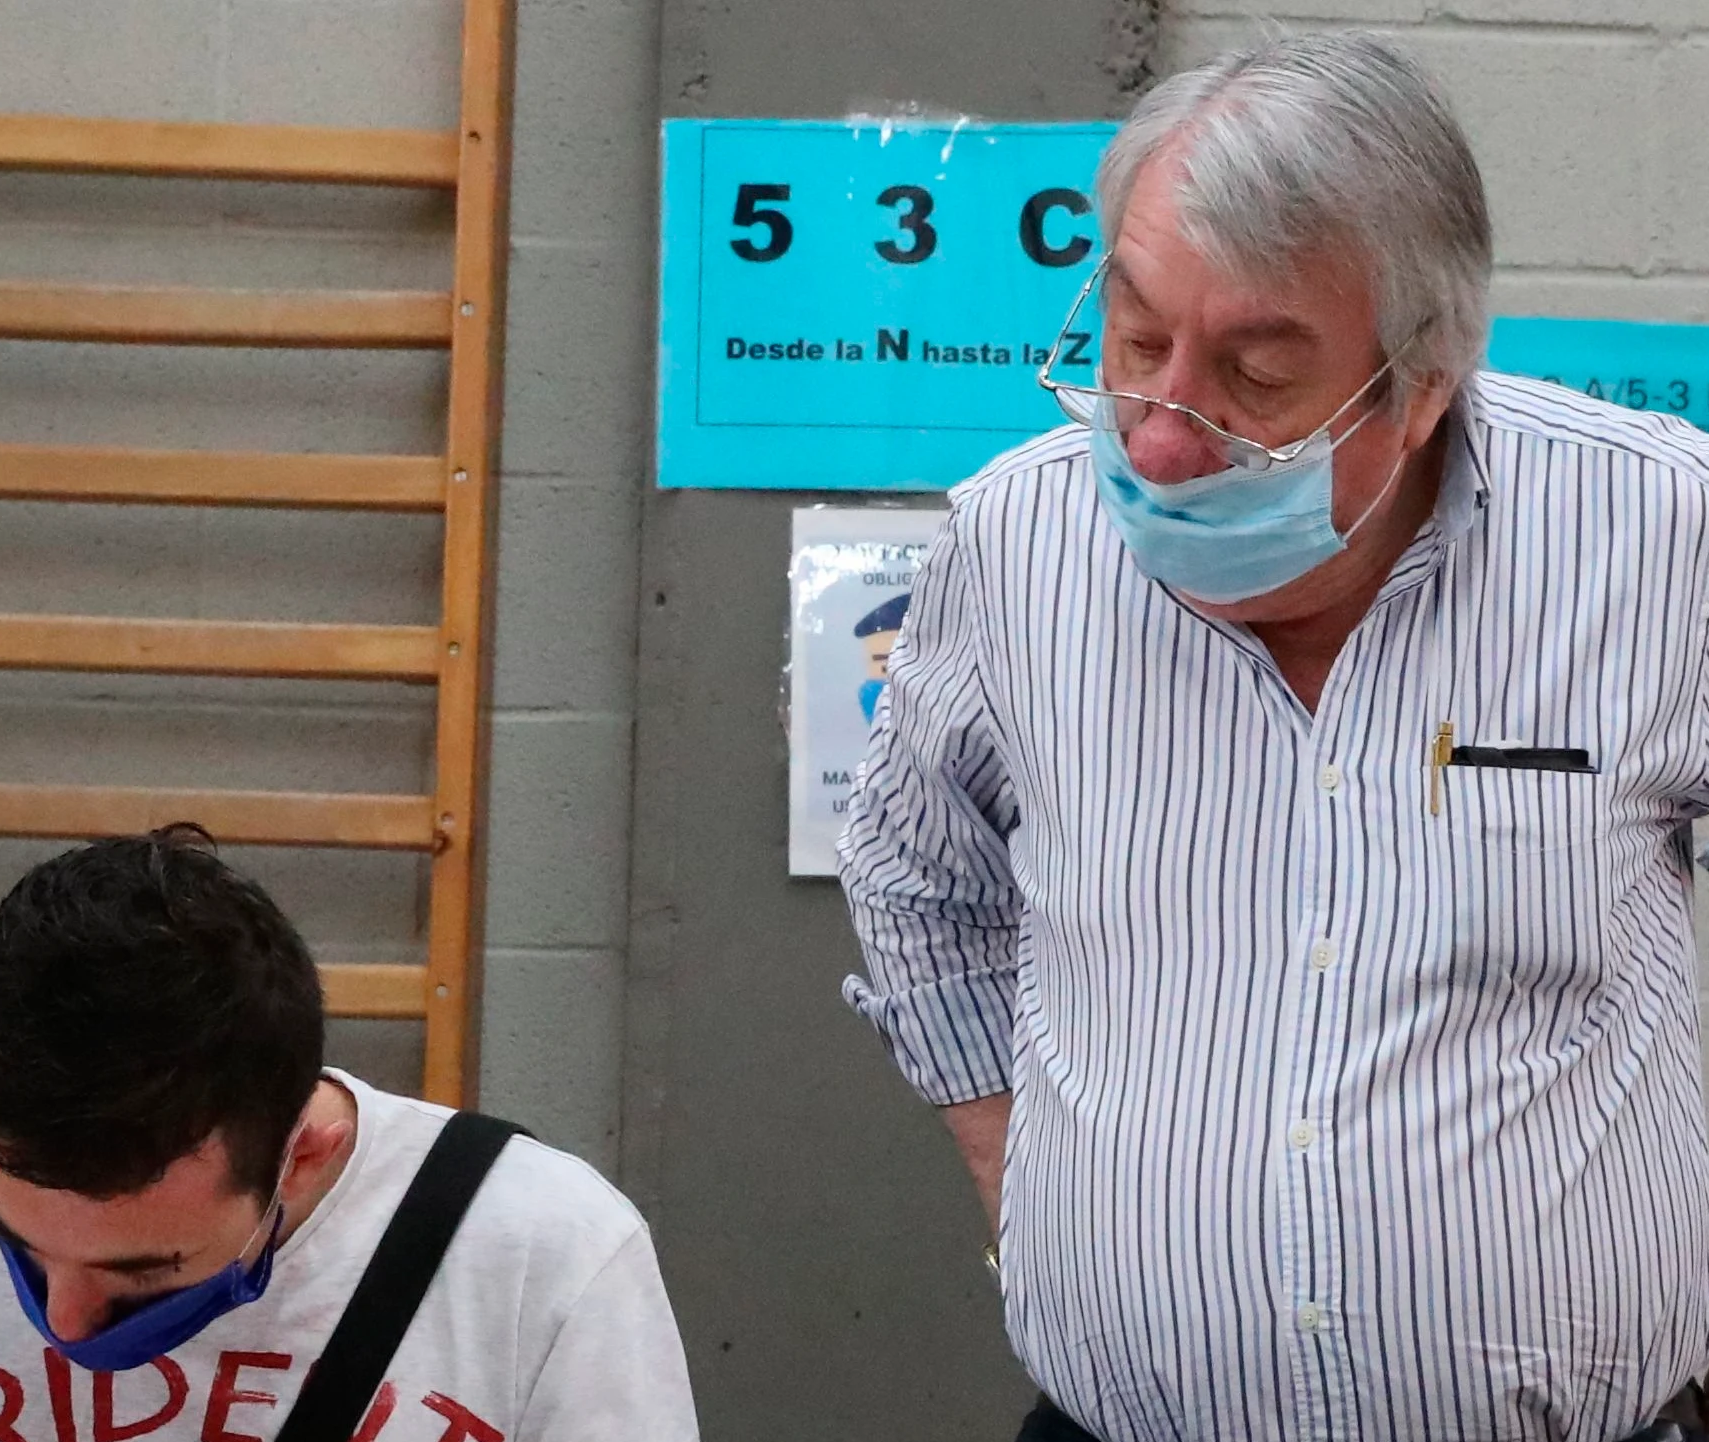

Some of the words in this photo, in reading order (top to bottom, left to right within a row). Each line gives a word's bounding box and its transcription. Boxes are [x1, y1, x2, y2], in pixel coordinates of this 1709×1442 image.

[731, 184, 793, 262] 5
[875, 185, 937, 264] 3
[1020, 188, 1092, 267] C
[727, 337, 824, 360] Desde
[836, 339, 863, 360] la
[878, 329, 910, 361] N
[922, 341, 1010, 365] hasta
[1021, 340, 1049, 366] la
[1062, 332, 1093, 366] Z
